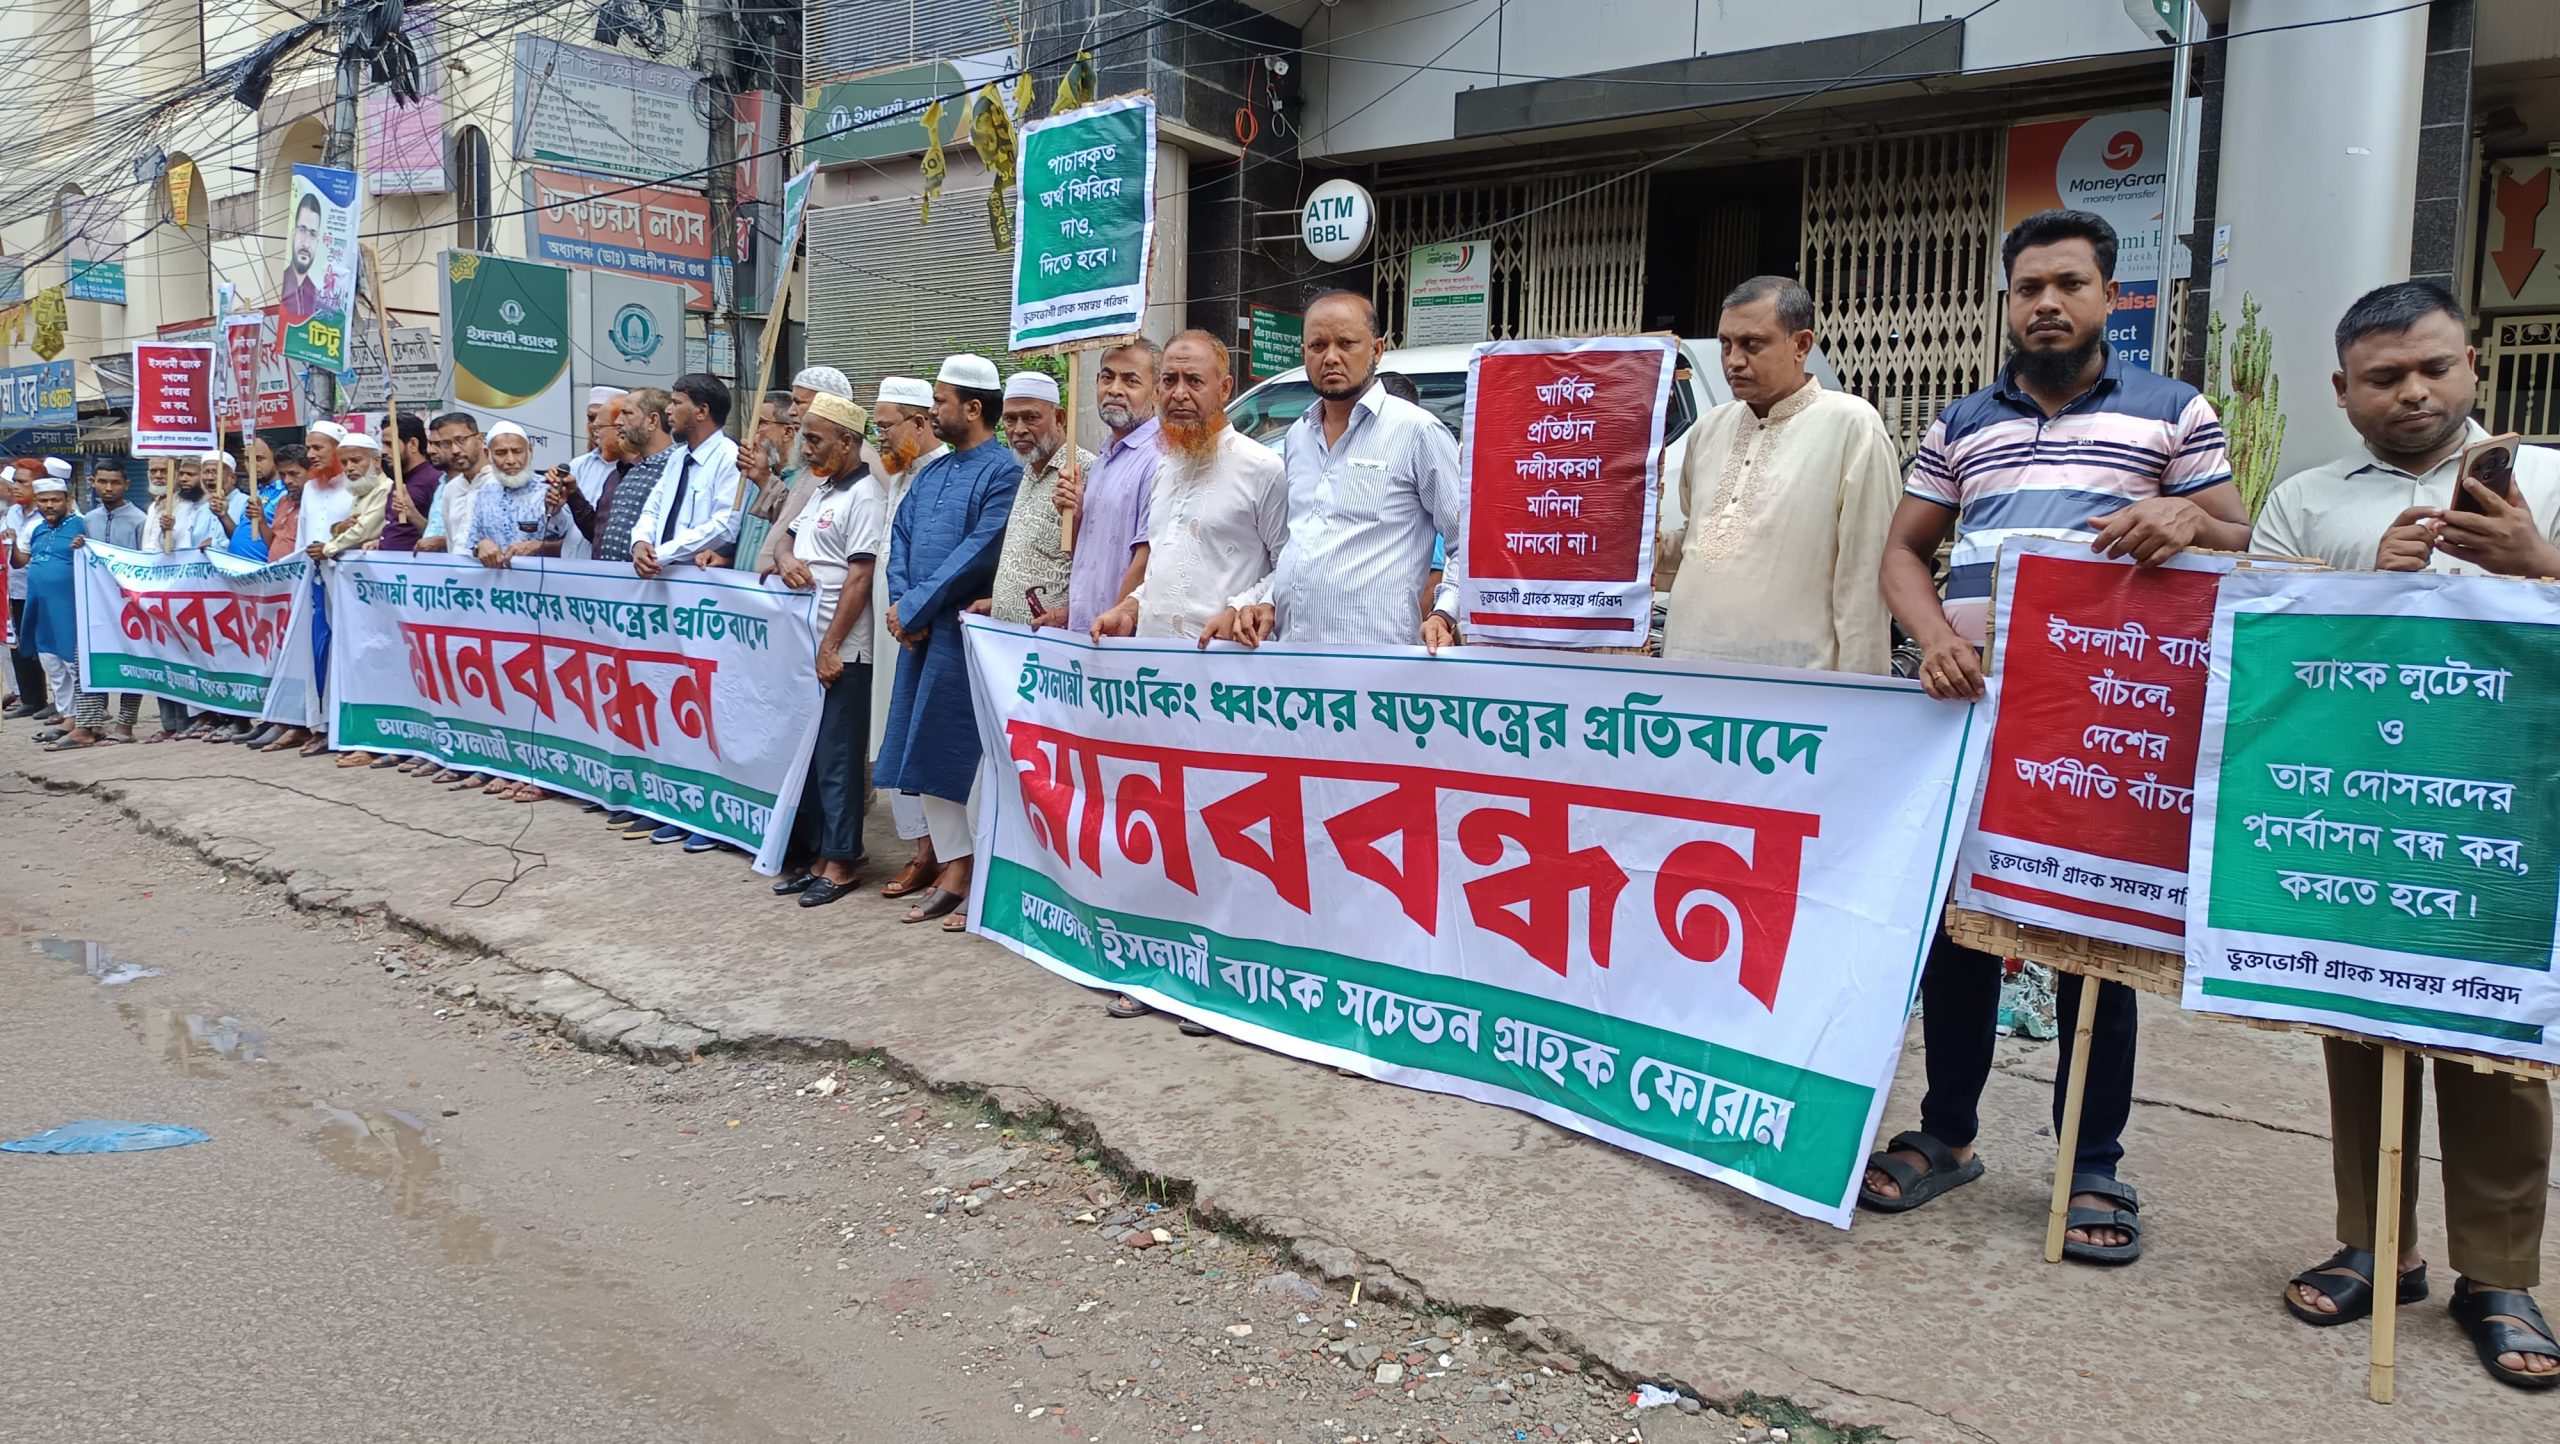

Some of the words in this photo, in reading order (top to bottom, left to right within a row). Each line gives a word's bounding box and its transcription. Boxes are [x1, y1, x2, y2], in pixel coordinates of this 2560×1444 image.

[1048, 143, 1117, 175] পাচারকৃত
[1040, 180, 1065, 209] অর্থ
[1069, 175, 1122, 205] ফিরিয়ে
[2083, 194, 2116, 204] money
[2117, 189, 2157, 201] transfer
[647, 204, 706, 246] ল্যাব
[1306, 196, 1354, 223] ATM
[1060, 217, 1094, 239] দাও,
[1308, 225, 1349, 244] IBBL
[547, 239, 593, 261] অধ্যাপক
[597, 248, 625, 269] (ডাঃ)
[628, 251, 666, 272] জয়দীপ
[1040, 251, 1072, 279] দিতে
[1077, 248, 1116, 272] হবে।
[1103, 294, 1129, 308] পরিষদ
[2117, 294, 2157, 309] aisa
[466, 325, 516, 345] ইসলামী
[519, 334, 558, 348] ব্যাংক
[2119, 350, 2149, 361] ere
[1535, 375, 1596, 406] আর্থিক
[32, 432, 60, 444] চশমা
[1527, 412, 1596, 443] প্রতিষ্ঠান
[1515, 451, 1602, 480] দলীয়করণ
[1526, 489, 1583, 518] মানিনা
[1505, 531, 1563, 555] মানবো
[1567, 531, 1597, 556] না।
[353, 573, 407, 606] ইসলামী
[413, 578, 483, 614] ব্যাংকিং
[491, 587, 563, 622] ধ্বংসের
[566, 595, 668, 640] ষড়যন্ত্রের
[673, 598, 768, 650] প্রতিবাদে
[1479, 587, 1519, 607] ভুক্তভোগী
[1522, 592, 1550, 606] গ্রাহক
[1553, 593, 1585, 608] সমন্বয়
[1588, 591, 1623, 607] পরিষদ
[2046, 614, 2151, 660] ইসলামী
[2158, 634, 2210, 671] ব্যাং
[398, 620, 720, 762] মানববন্ধন
[2089, 667, 2178, 717] বাঁচলে,
[2294, 656, 2389, 695] ব্যাংক
[2400, 655, 2513, 704] লুটেরা
[1017, 651, 1083, 707] ইসলামী
[1090, 667, 1200, 722] ব্যাংকিং
[1210, 687, 1356, 733] ধ্বংসের
[1370, 692, 1567, 759] ষড়যন্ত্রের
[1585, 691, 1827, 776] প্রতিবাদে
[2082, 724, 2169, 763] দেশের
[2377, 720, 2404, 746] ও
[434, 721, 512, 762] ইসলামী
[514, 739, 568, 775] ব্যাংক
[572, 756, 637, 794] সচেতন
[642, 772, 706, 813] গ্রাহক
[711, 788, 772, 836] ফোরা
[2015, 755, 2118, 803] অর্থনীতি
[2267, 762, 2334, 797] তার
[2344, 769, 2516, 814] দোসরদের
[2242, 809, 2381, 855] পুনর্বাসন
[2392, 828, 2448, 861] বন্ধ
[2459, 832, 2529, 876] কর,
[1006, 719, 1820, 1013] মানববন্ধন
[1988, 849, 2058, 880] ভুক্তভোগী
[2063, 866, 2105, 889] গ্রাহক
[2110, 874, 2163, 902] সমন্বয়
[2277, 869, 2379, 906] করতে
[2390, 885, 2478, 919] হবে।
[2226, 947, 2319, 977] ভুক্তভোগী
[2324, 957, 2374, 983] গ্রাহক
[2379, 966, 2443, 994] সমন্বয়
[2451, 975, 2522, 1005] পরিষদ
[1096, 916, 1210, 988] ইসলামী
[1219, 956, 1327, 1015] ব্যাংক
[1337, 979, 1480, 1053] সচেতন
[1493, 1015, 1620, 1093] গ্রাহক
[1630, 1054, 1796, 1153] ফোরাম
